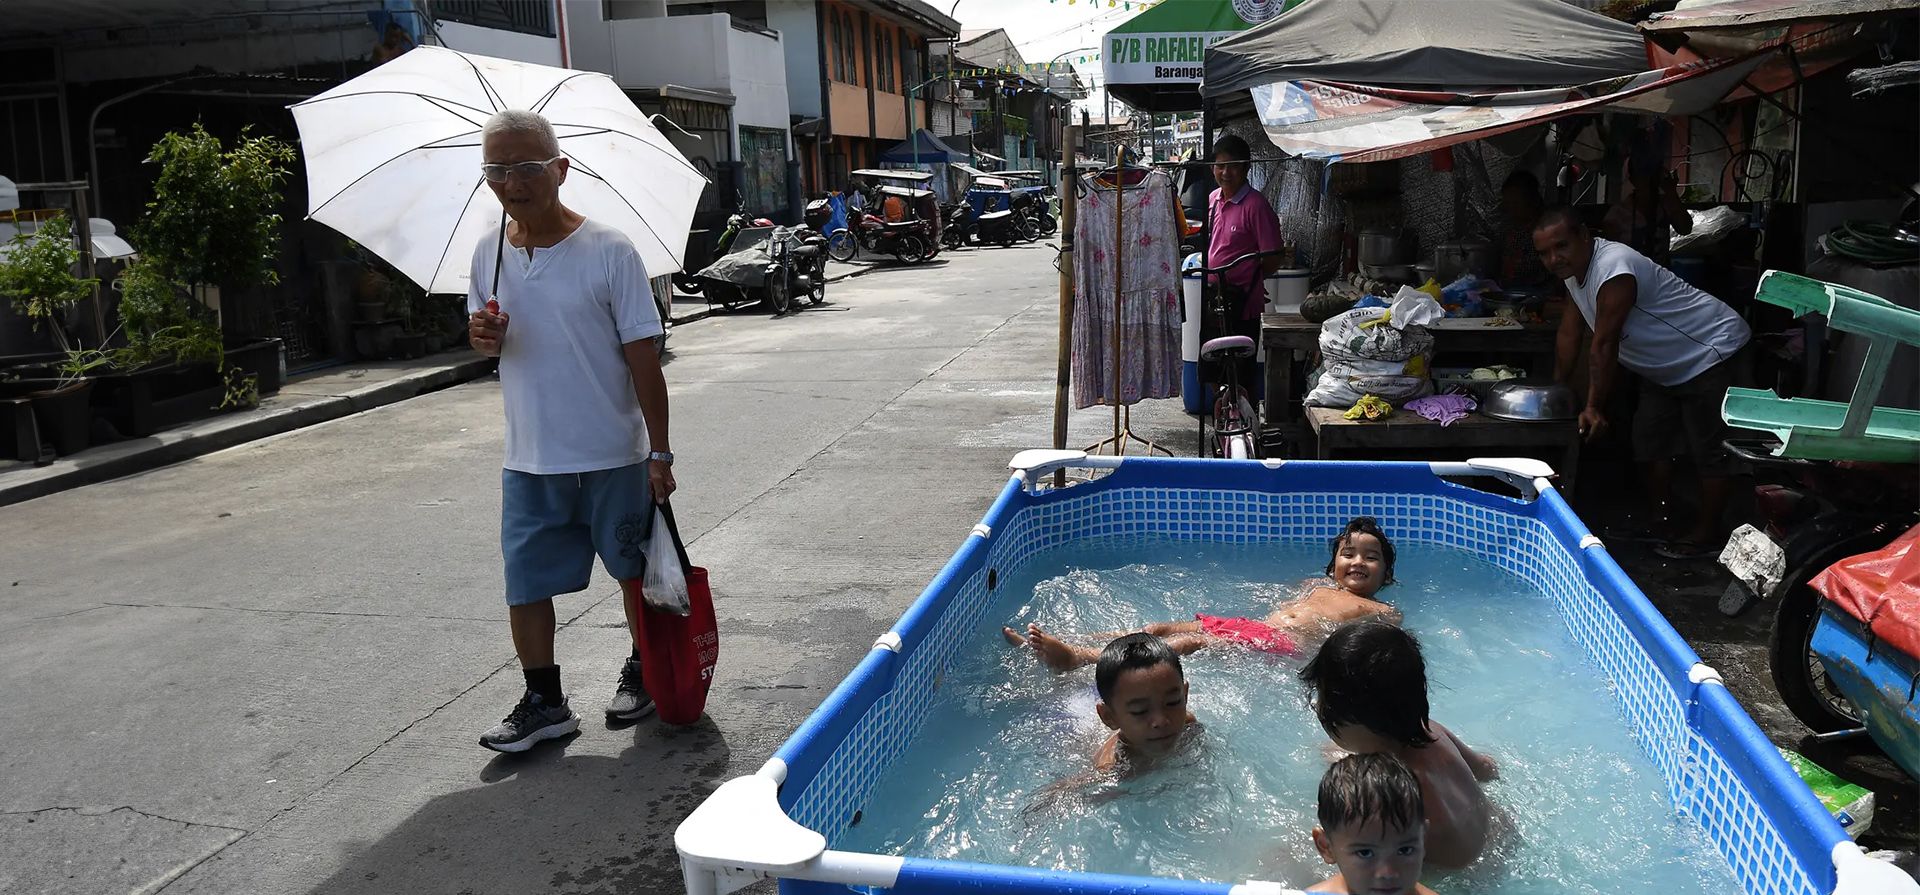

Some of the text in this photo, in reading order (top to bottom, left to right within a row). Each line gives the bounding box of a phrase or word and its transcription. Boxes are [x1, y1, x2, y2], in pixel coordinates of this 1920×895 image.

[1111, 37, 1204, 64] P/B RAFAEL
[1155, 66, 1203, 79] Baranga
[701, 665, 714, 680] ST
